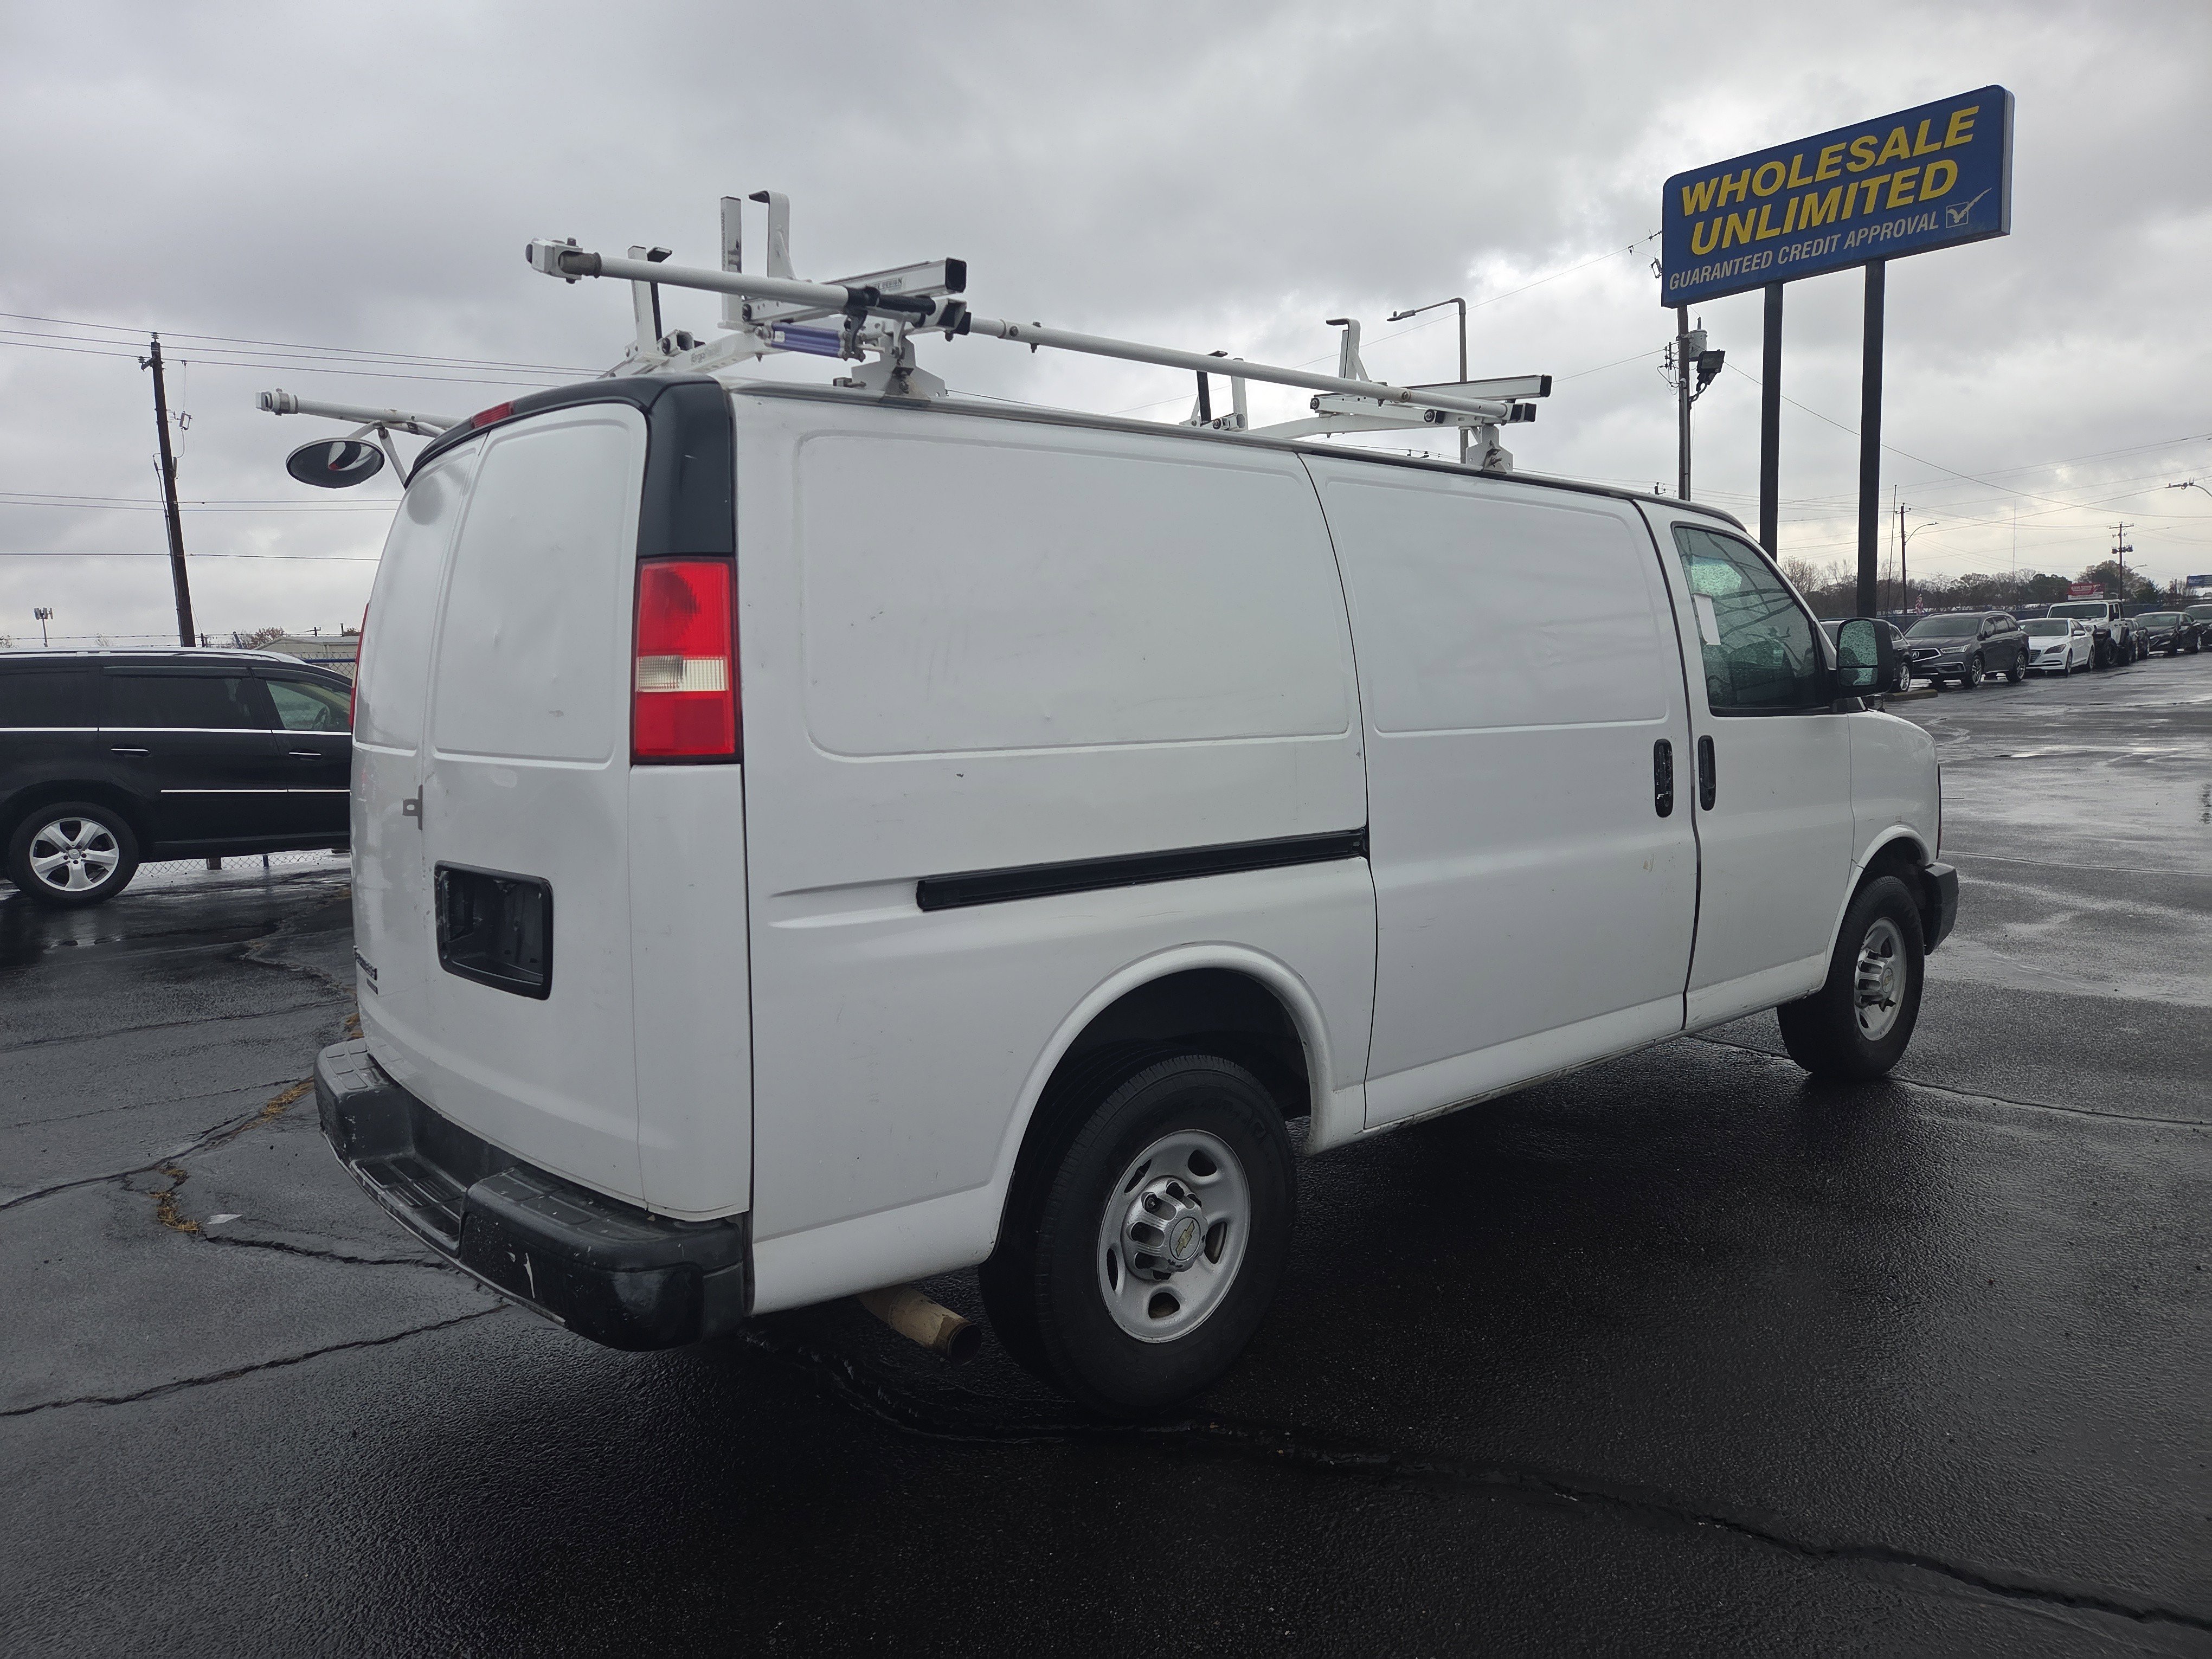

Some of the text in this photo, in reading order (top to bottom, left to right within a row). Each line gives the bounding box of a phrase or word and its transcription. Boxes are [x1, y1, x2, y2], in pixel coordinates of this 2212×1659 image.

[1682, 105, 1980, 216] WHOLESALE
[1692, 159, 1958, 256] UNLIMITED
[1669, 211, 1939, 290] GUARANTEED CREDIT APPROVAL
